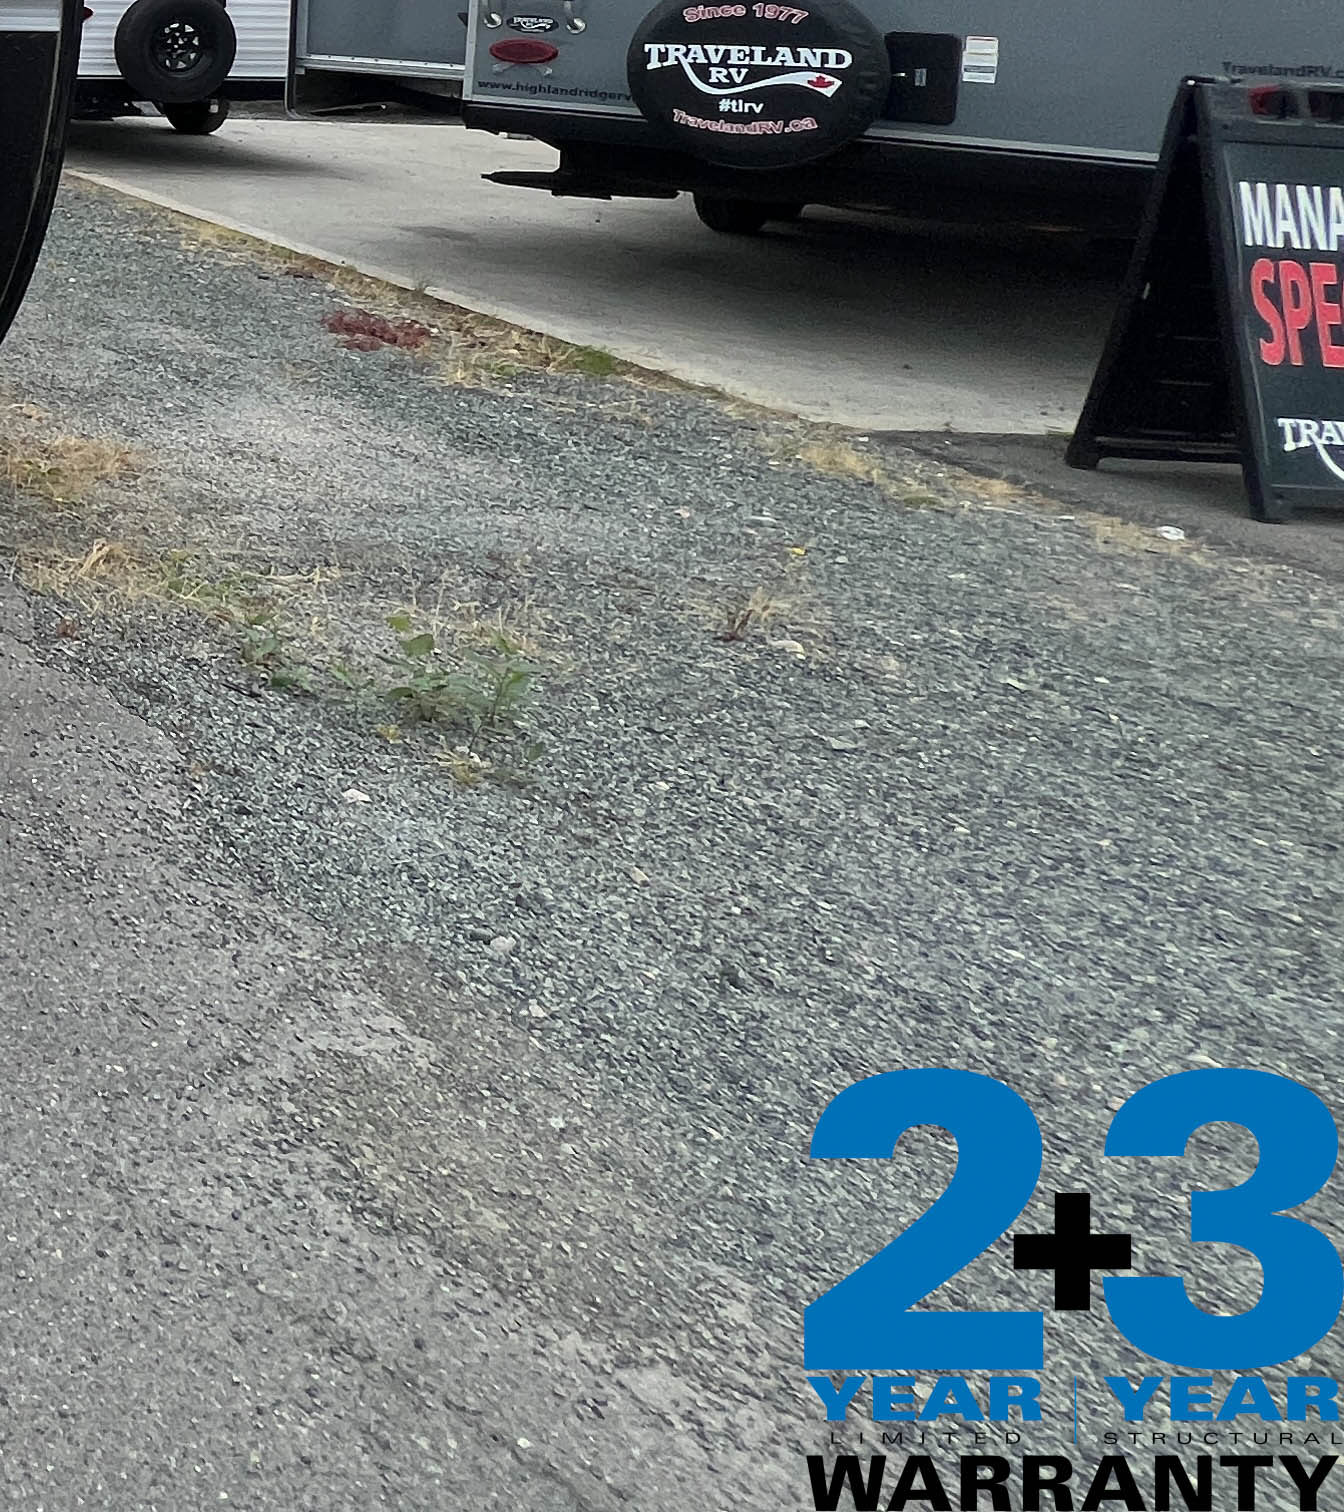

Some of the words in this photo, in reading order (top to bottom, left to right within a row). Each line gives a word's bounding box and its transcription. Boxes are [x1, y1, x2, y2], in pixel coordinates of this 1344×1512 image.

[683, 3, 747, 22] Since
[752, 3, 809, 24] 1977
[644, 43, 853, 70] TRAVELAND
[708, 66, 749, 84] RV
[672, 108, 819, 135] TravelandRV.ca
[1250, 258, 1344, 368] SPE
[1277, 417, 1344, 452] TRA
